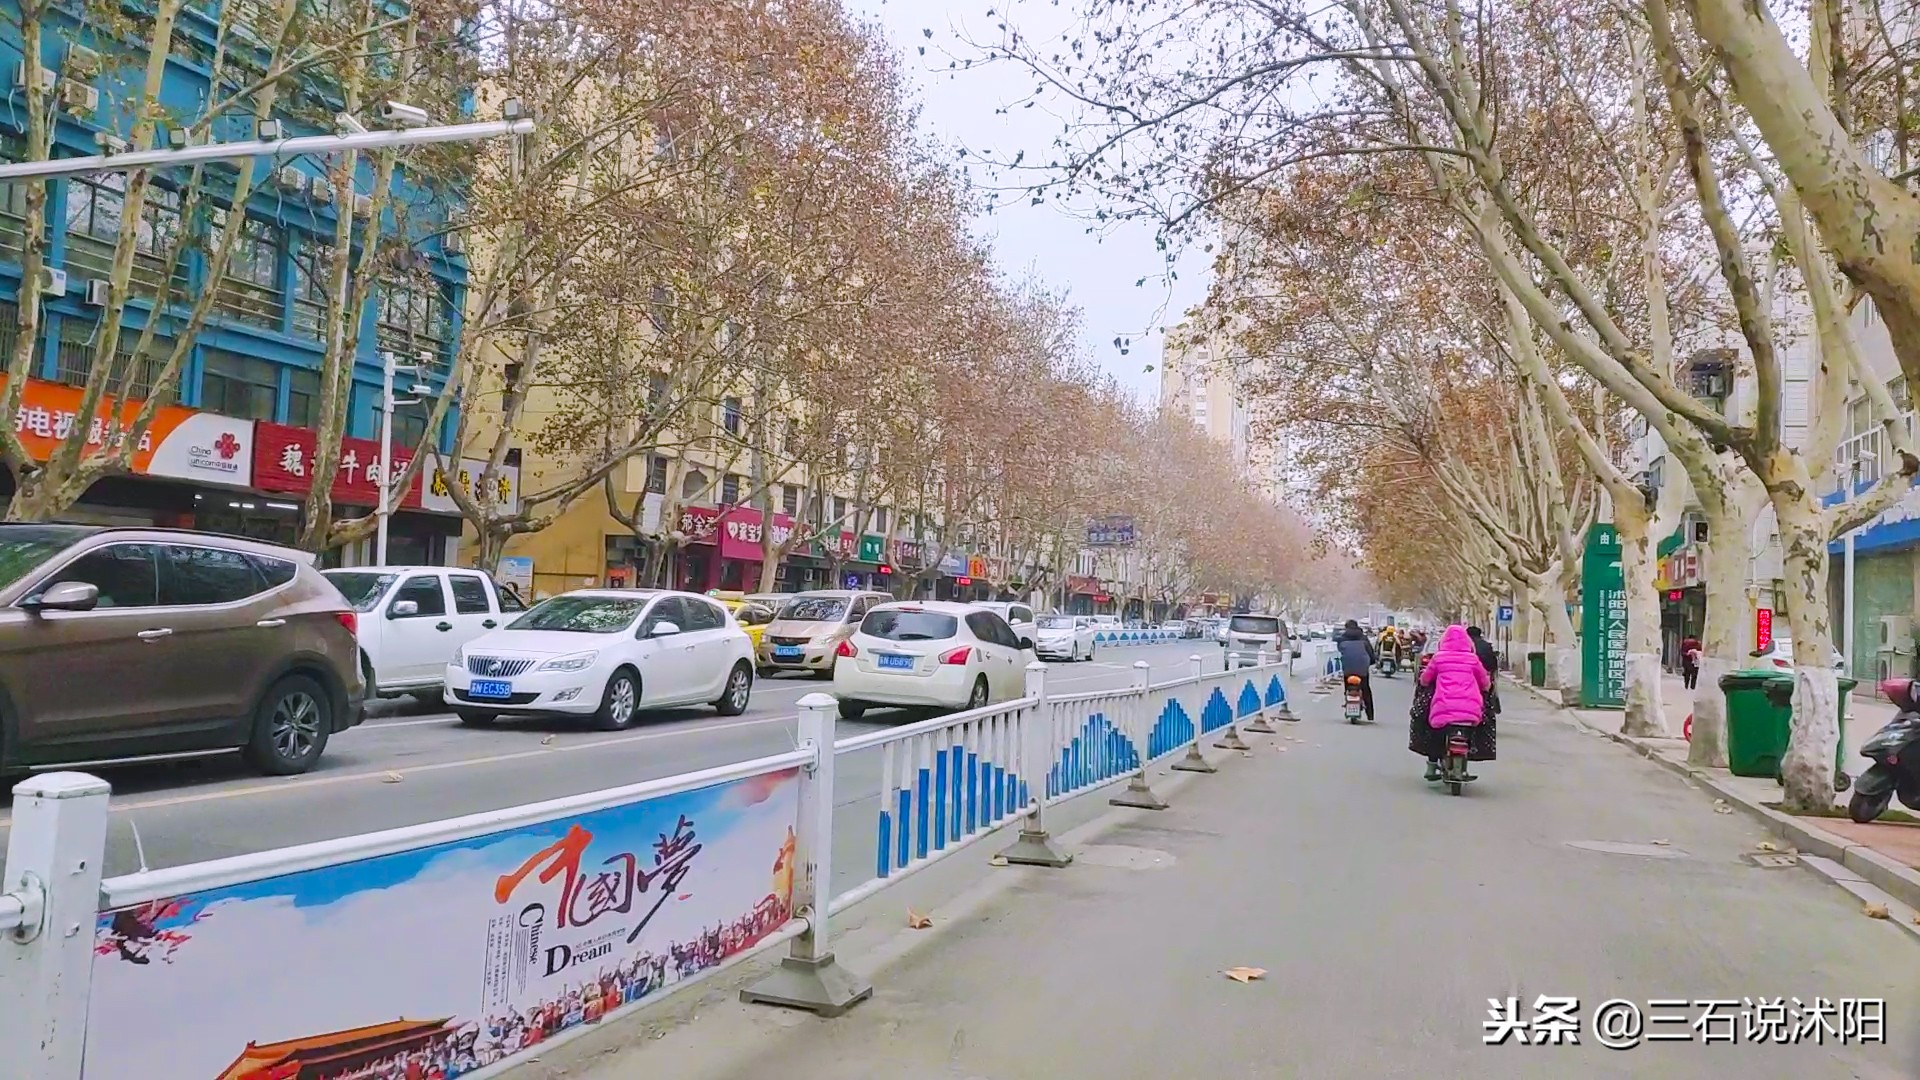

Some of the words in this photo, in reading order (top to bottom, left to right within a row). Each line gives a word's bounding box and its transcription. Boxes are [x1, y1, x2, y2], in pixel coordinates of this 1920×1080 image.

[1502, 608, 1513, 619] P
[518, 902, 546, 966] Chinese
[542, 942, 613, 978] Dream
